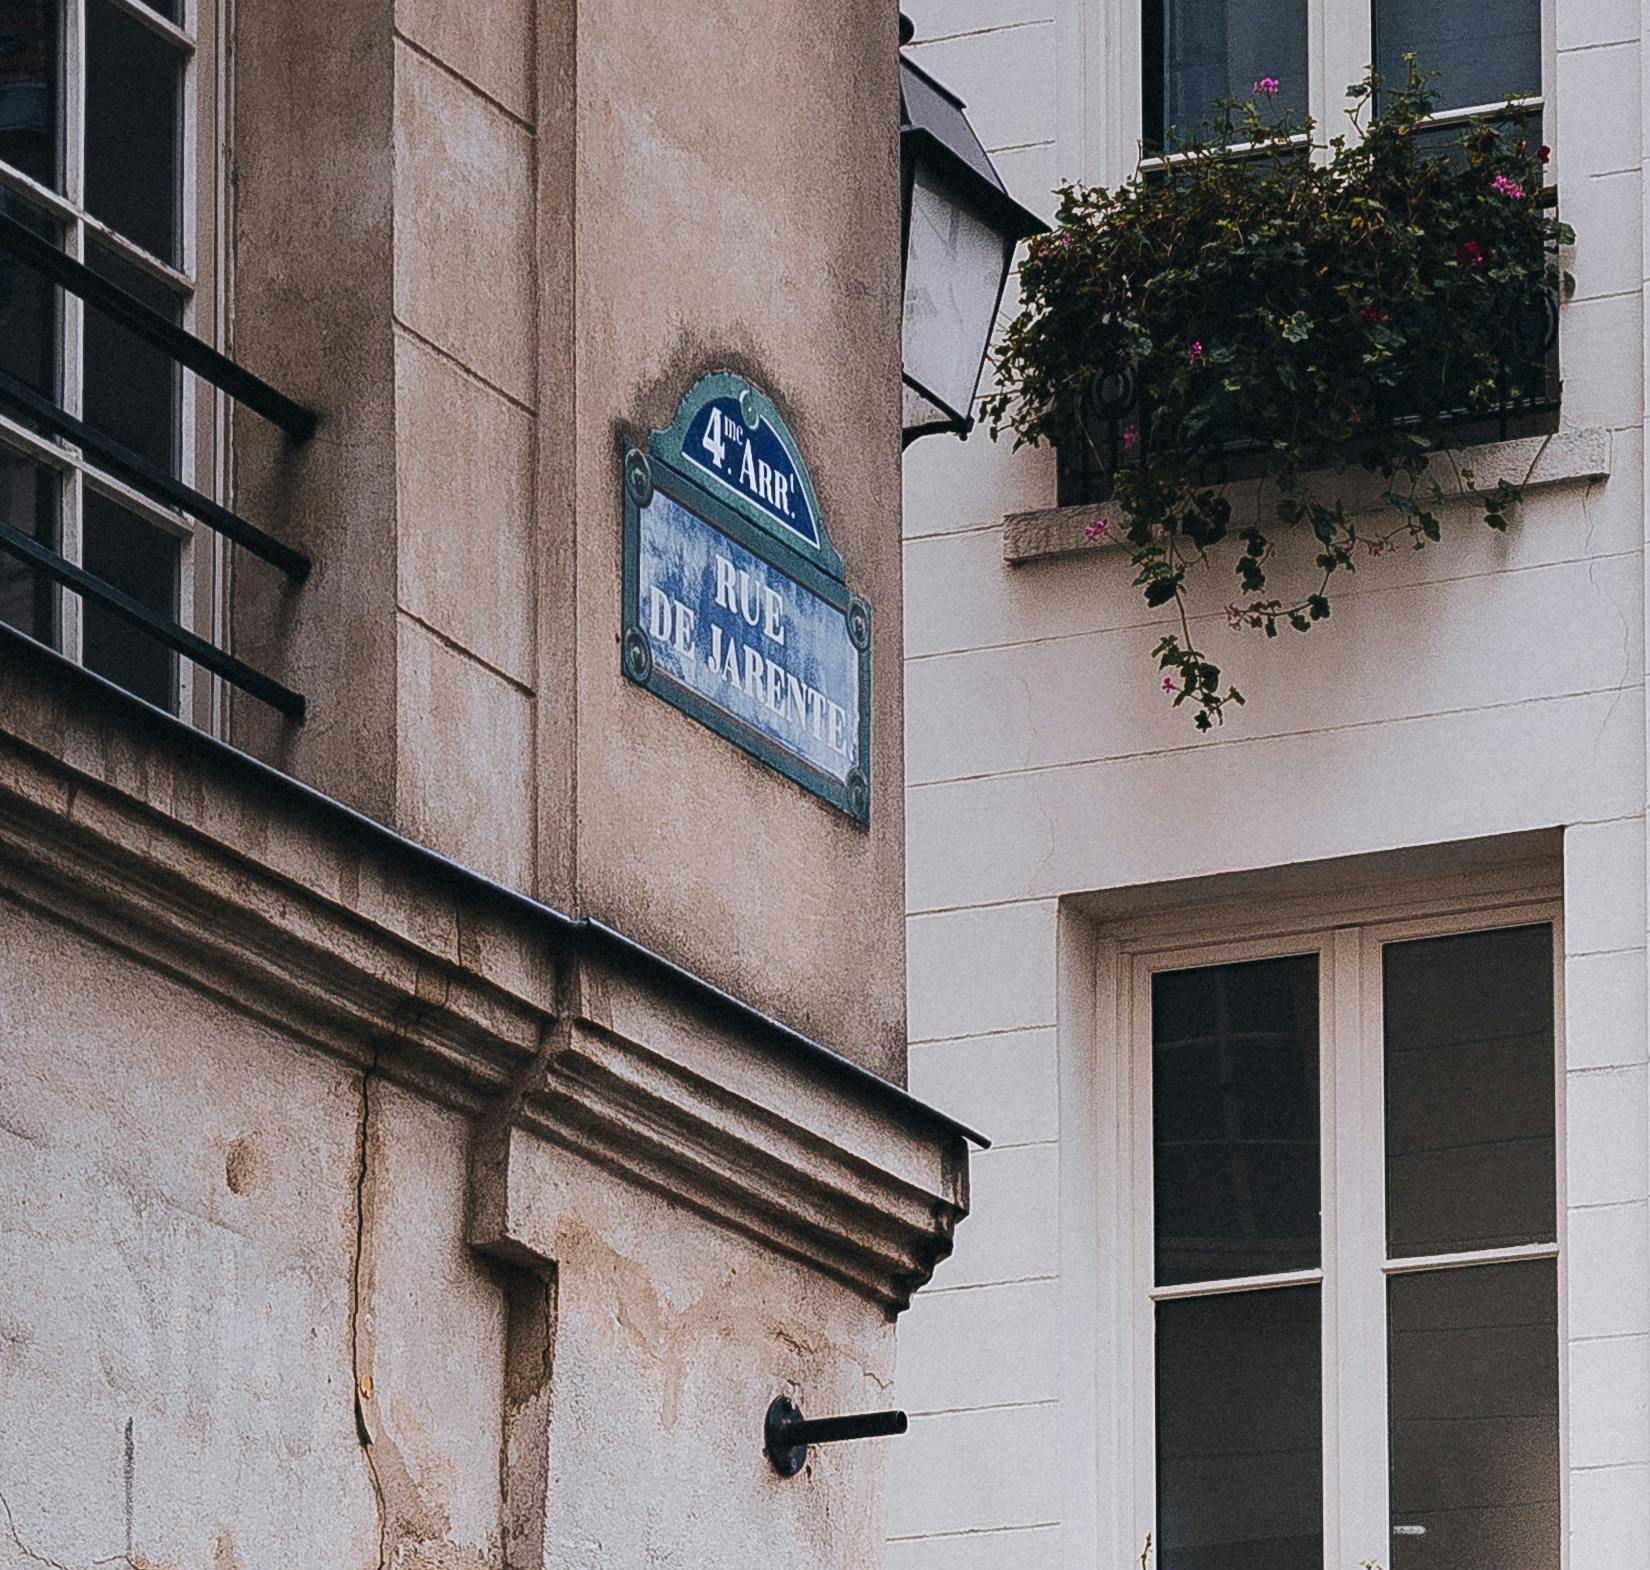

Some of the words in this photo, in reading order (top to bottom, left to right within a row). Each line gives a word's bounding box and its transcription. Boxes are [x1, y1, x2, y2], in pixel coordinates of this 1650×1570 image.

[715, 553, 785, 646] RUE
[649, 585, 698, 658] DE
[707, 623, 848, 757] JARENTE
